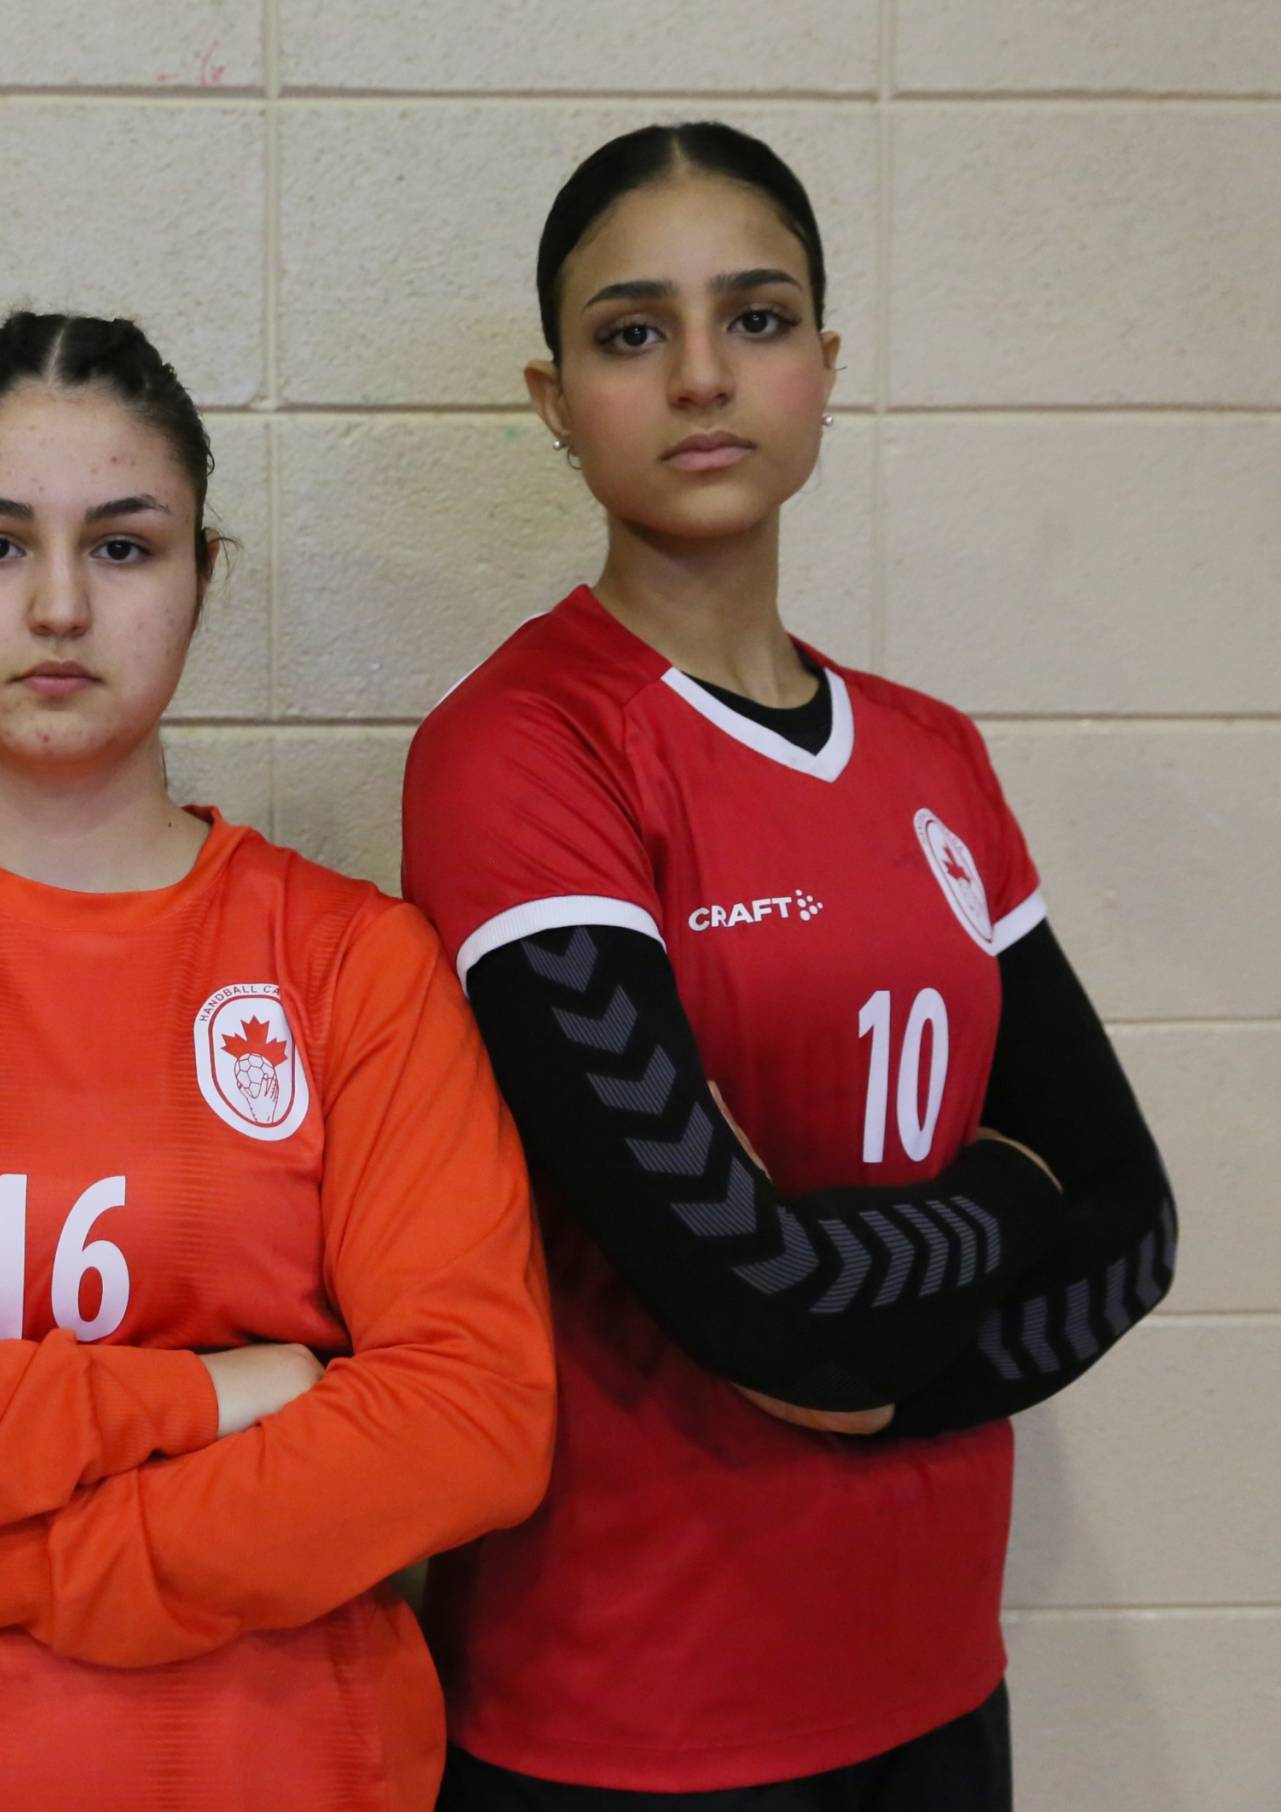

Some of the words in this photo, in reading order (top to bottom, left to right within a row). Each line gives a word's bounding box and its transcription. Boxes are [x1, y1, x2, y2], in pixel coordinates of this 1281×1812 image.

[688, 897, 792, 931] CRAFT
[199, 985, 257, 1022] HANDBALL
[858, 987, 949, 1163] 10
